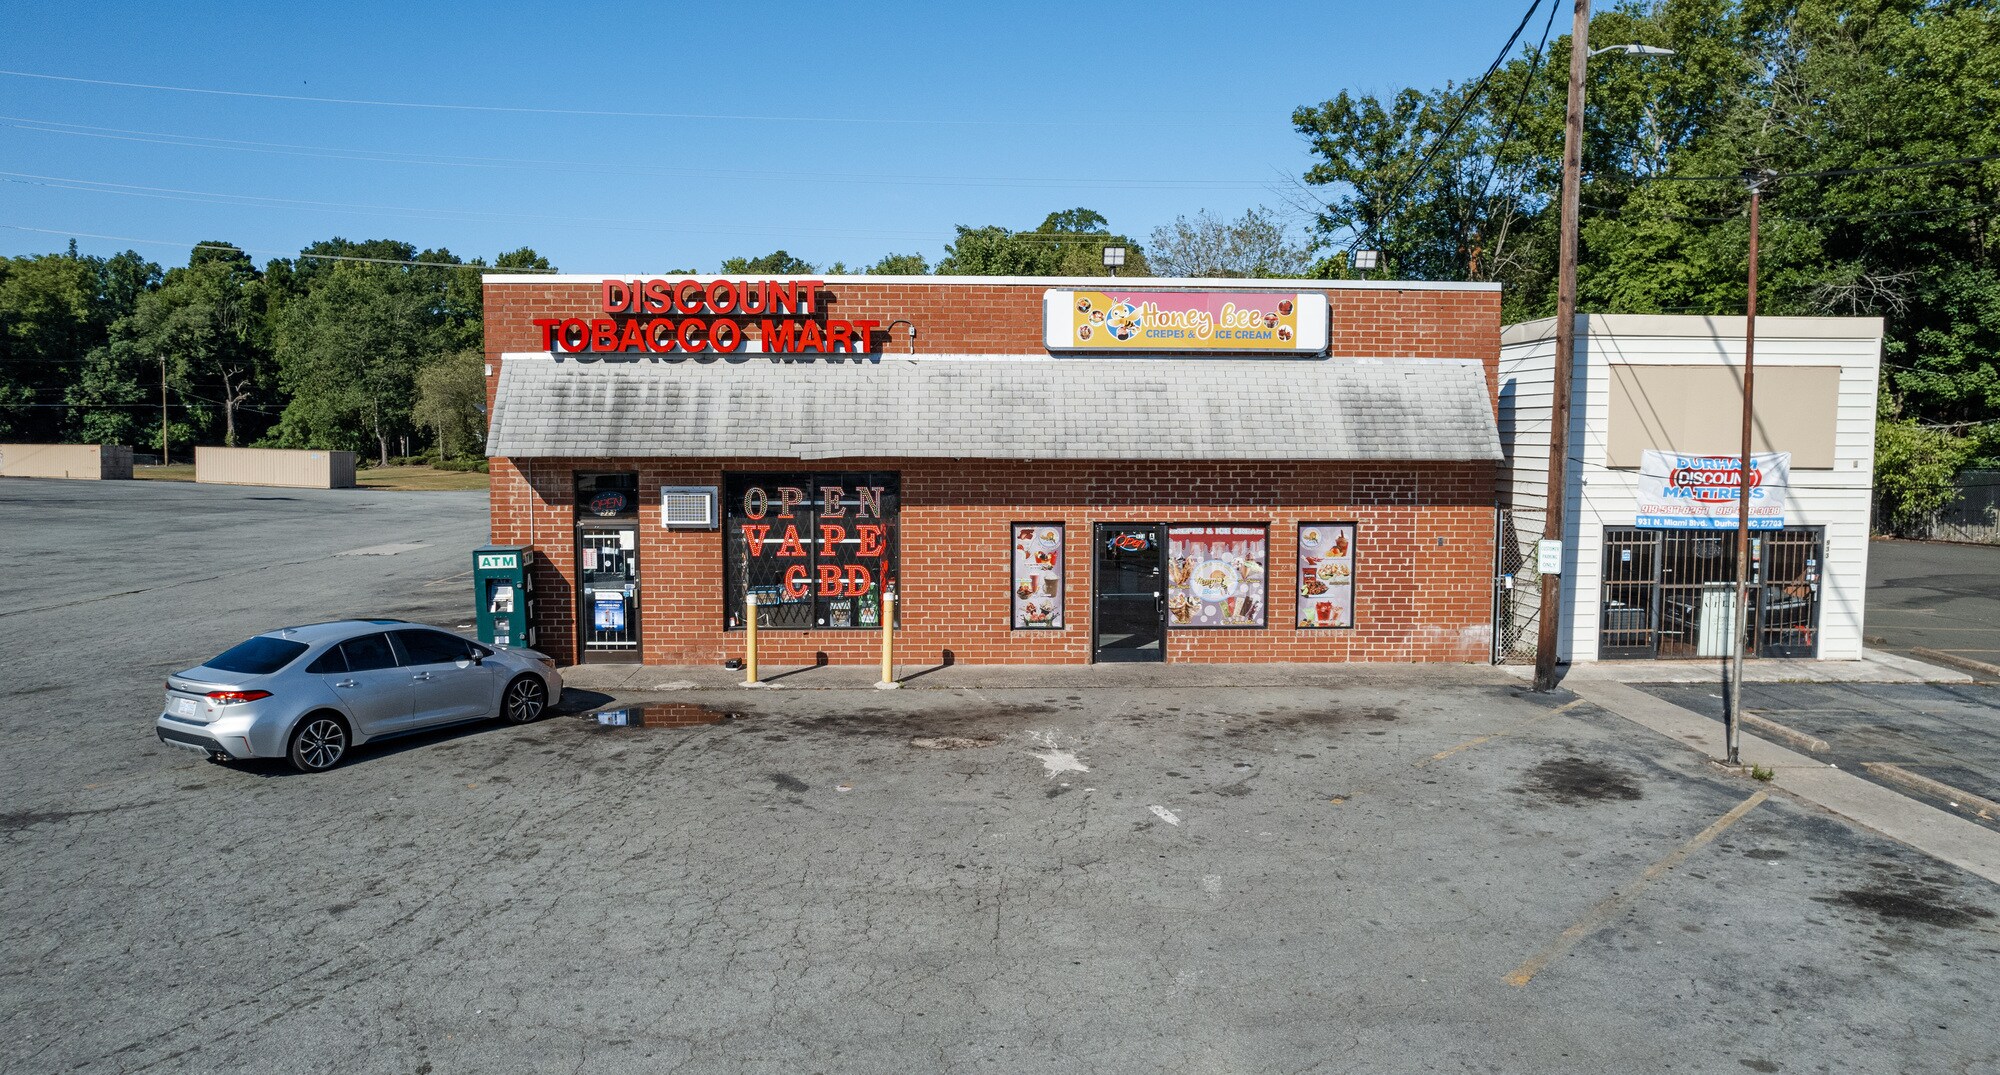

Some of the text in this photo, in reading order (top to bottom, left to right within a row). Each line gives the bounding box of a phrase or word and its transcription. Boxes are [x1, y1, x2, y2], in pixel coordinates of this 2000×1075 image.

[602, 279, 824, 314] DISCOUNT
[533, 318, 881, 354] TOBACCO MART
[1141, 301, 1214, 340] Honey
[1145, 329, 1273, 340] CREPES & ICE CREAM
[591, 496, 623, 511] OPEN
[744, 487, 885, 520] OPEN
[1638, 518, 1651, 526] 931
[1664, 519, 1688, 527] Miami
[1689, 519, 1708, 528] Blvd.
[742, 524, 883, 557] VAPE
[482, 556, 514, 567] ATM
[784, 564, 872, 598] CBD
[526, 573, 537, 647] ATM
